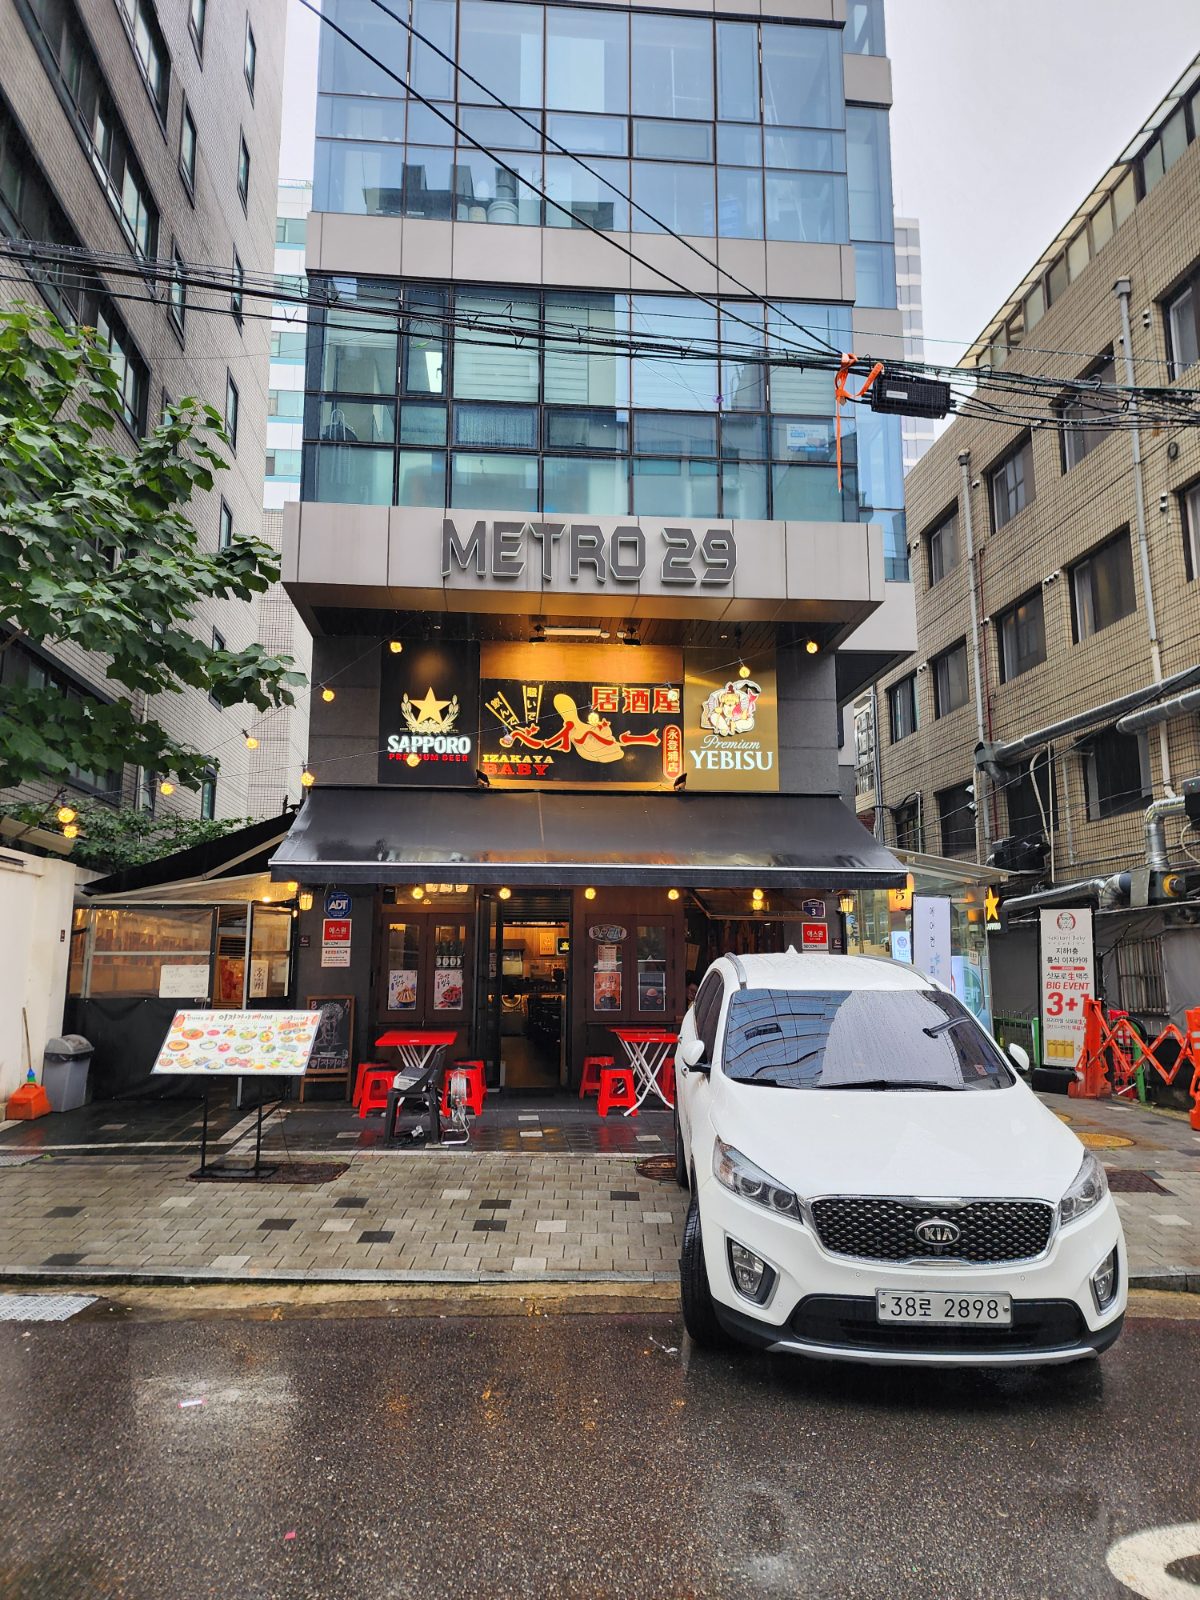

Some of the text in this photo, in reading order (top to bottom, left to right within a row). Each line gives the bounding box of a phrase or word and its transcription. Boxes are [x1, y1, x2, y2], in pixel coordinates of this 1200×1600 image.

[441, 518, 737, 584] METRO 29
[592, 686, 681, 714] 居酒屋
[387, 735, 471, 754] SAPPORO
[700, 734, 761, 750] Premium
[666, 729, 679, 773] 永登浦店
[441, 754, 469, 762] BEER
[482, 754, 555, 763] IZAKAYA
[688, 749, 774, 771] YEBISU
[482, 763, 550, 776] BABY
[328, 899, 349, 910] ADT
[811, 908, 817, 916] 3
[328, 926, 347, 935] 에스원
[806, 930, 824, 938] 에스원
[1055, 947, 1079, 955] 지하1층
[1062, 956, 1088, 964] 이자카야
[1046, 981, 1091, 990] BIG EVENT
[923, 1227, 953, 1241] KIA
[890, 1296, 999, 1319] 38로 2898
